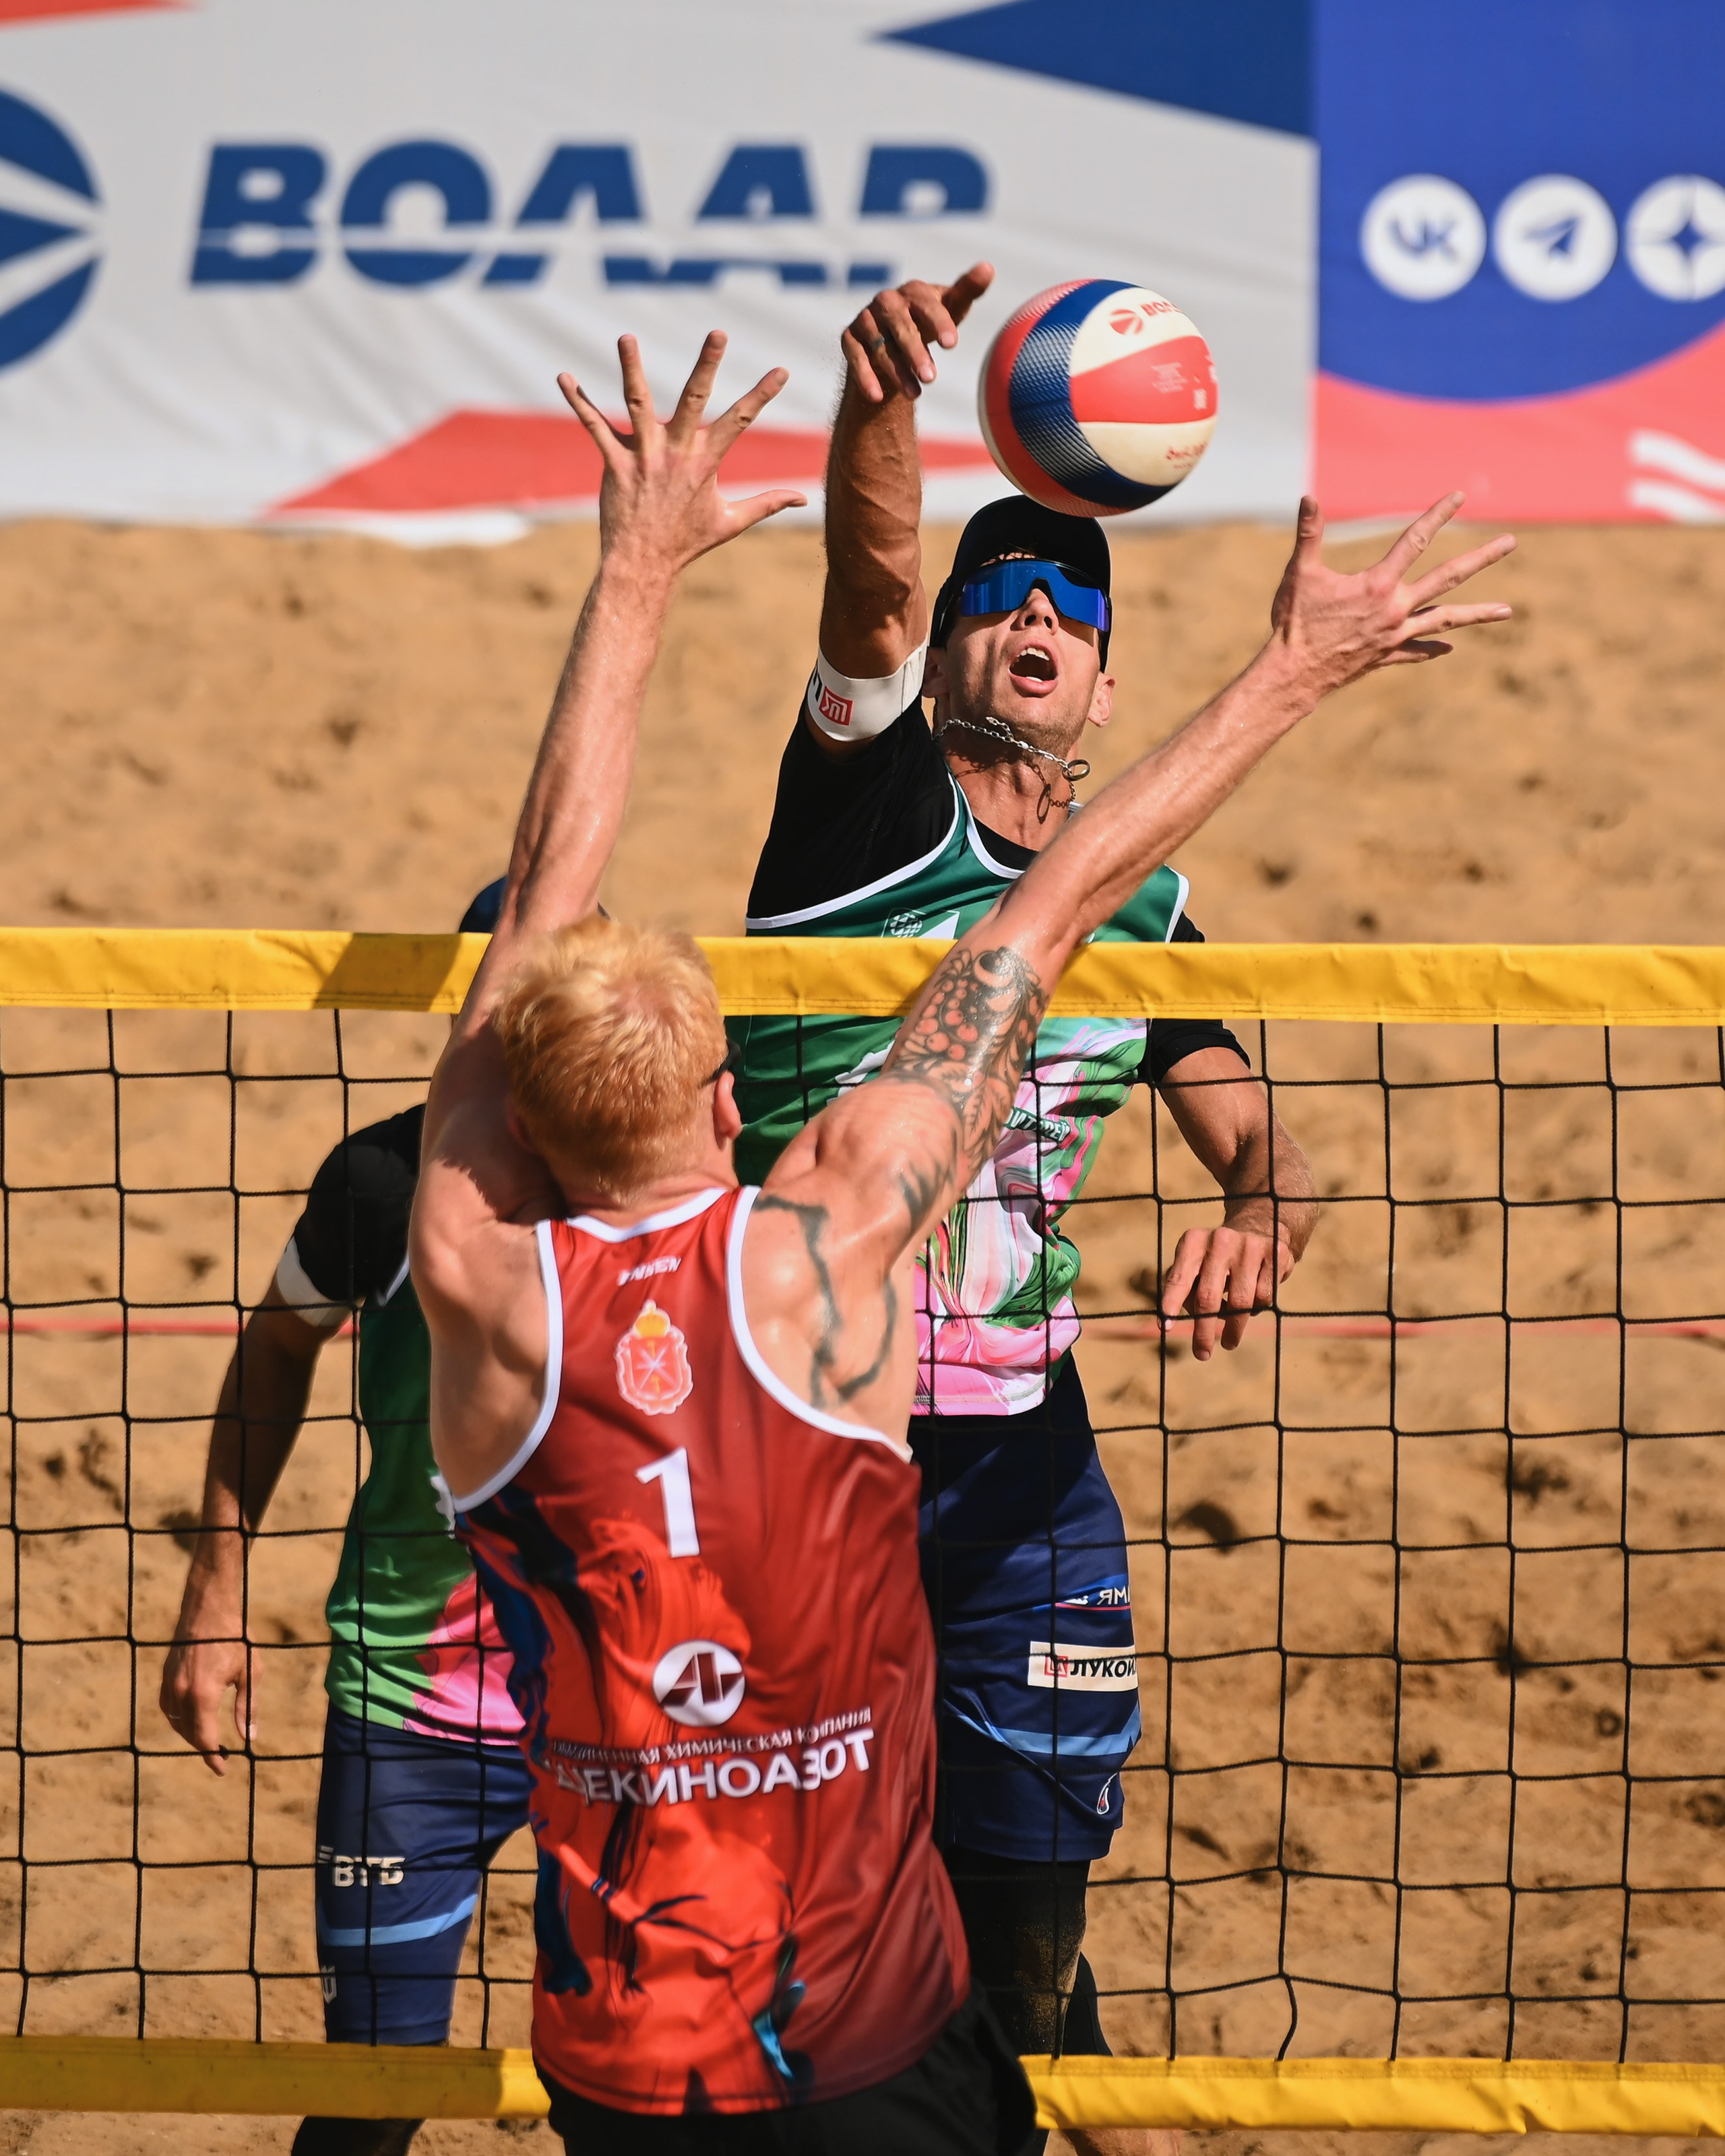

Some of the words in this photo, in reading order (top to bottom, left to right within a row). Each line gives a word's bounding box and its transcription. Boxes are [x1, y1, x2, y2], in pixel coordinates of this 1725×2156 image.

[189, 139, 989, 290] ВОЛАР
[635, 1447, 701, 1558] 1
[1096, 1585, 1131, 1606] ЯМ
[1070, 1657, 1136, 1678] ЛУКОЙ
